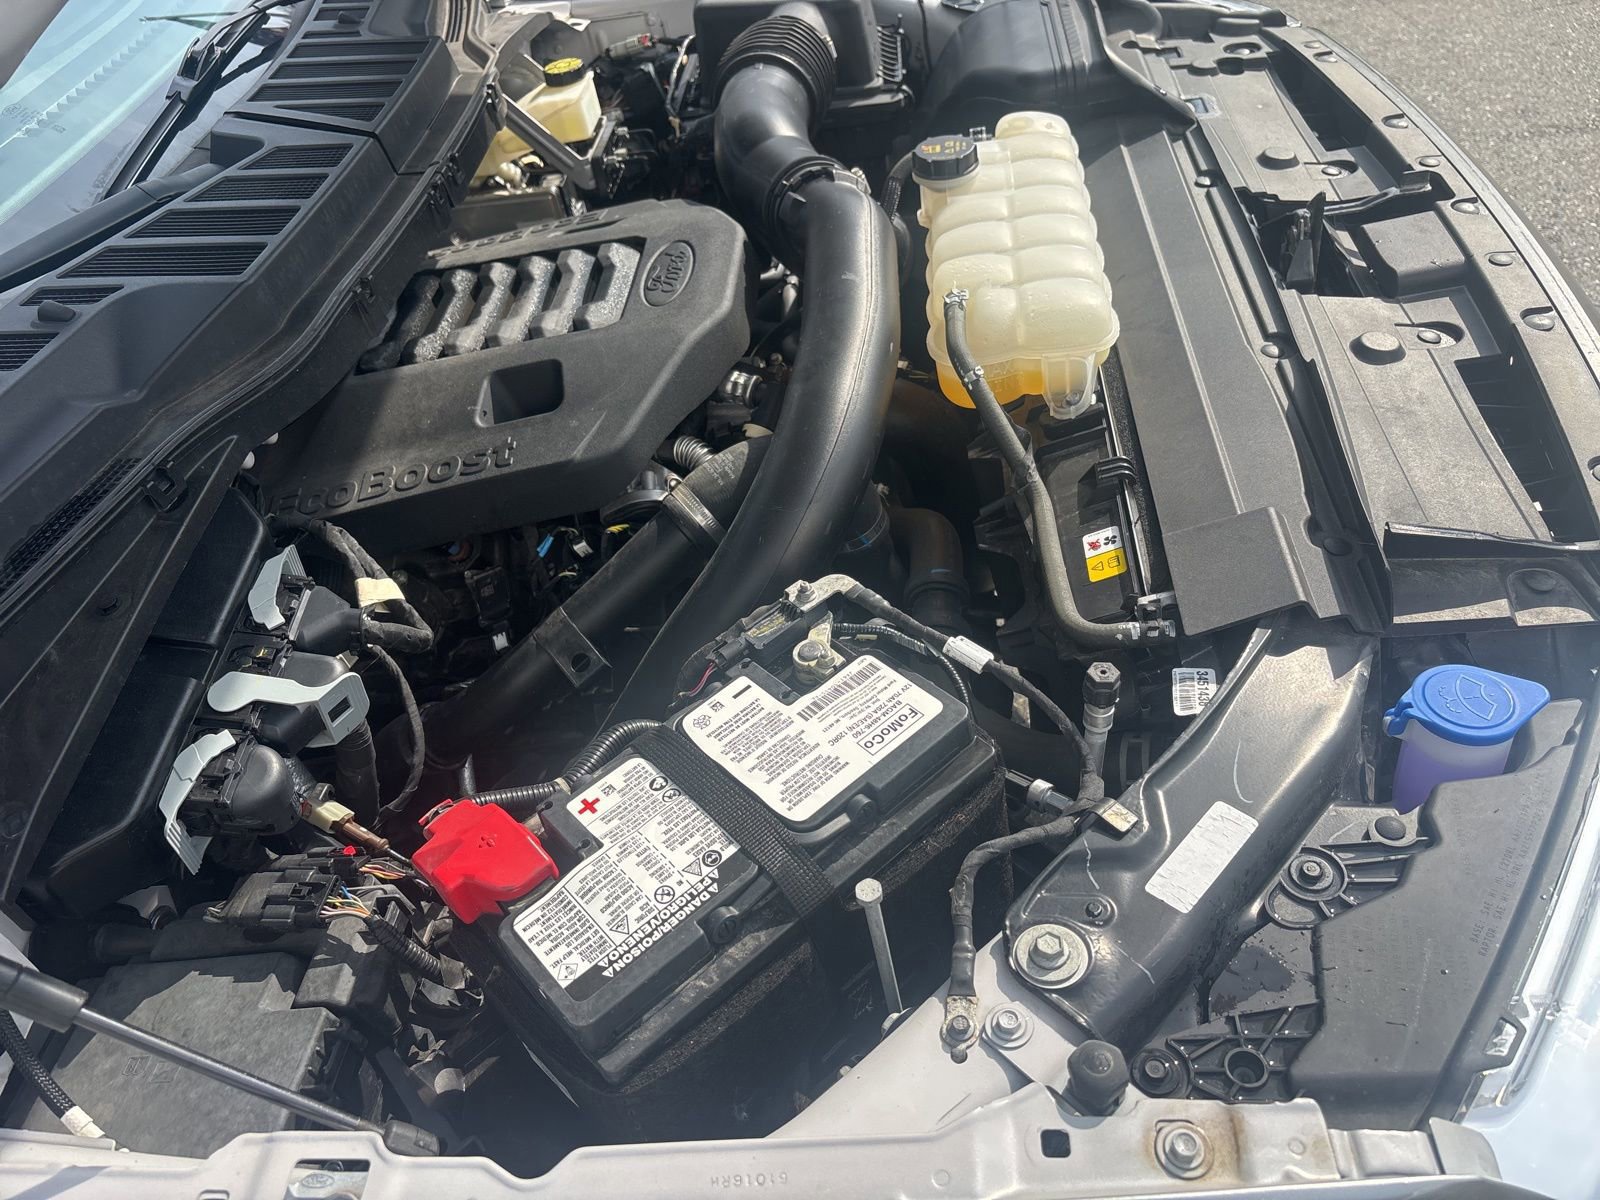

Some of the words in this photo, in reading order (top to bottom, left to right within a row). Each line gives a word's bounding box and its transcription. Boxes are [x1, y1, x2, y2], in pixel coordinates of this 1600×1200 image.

[900, 683, 912, 691] 12V
[871, 702, 888, 714] 720A
[846, 712, 873, 731] (SAE/EN)
[863, 707, 916, 751] FoMoCo
[826, 730, 848, 746] 120RC
[554, 915, 563, 923] LES
[578, 918, 590, 929] OJOS
[606, 876, 712, 961] PELIGRO/VENENO
[542, 921, 555, 931] YEUX
[612, 890, 711, 972] DANGER/POISON
[589, 928, 600, 938] GET
[564, 939, 574, 948] LOS
[572, 935, 591, 951] MEDICAL
[592, 934, 604, 945] WITH
[580, 938, 608, 962] IMMEDIATELY
[597, 942, 612, 955] FLUSH
[561, 949, 573, 960] HELP
[587, 953, 599, 963] EYES
